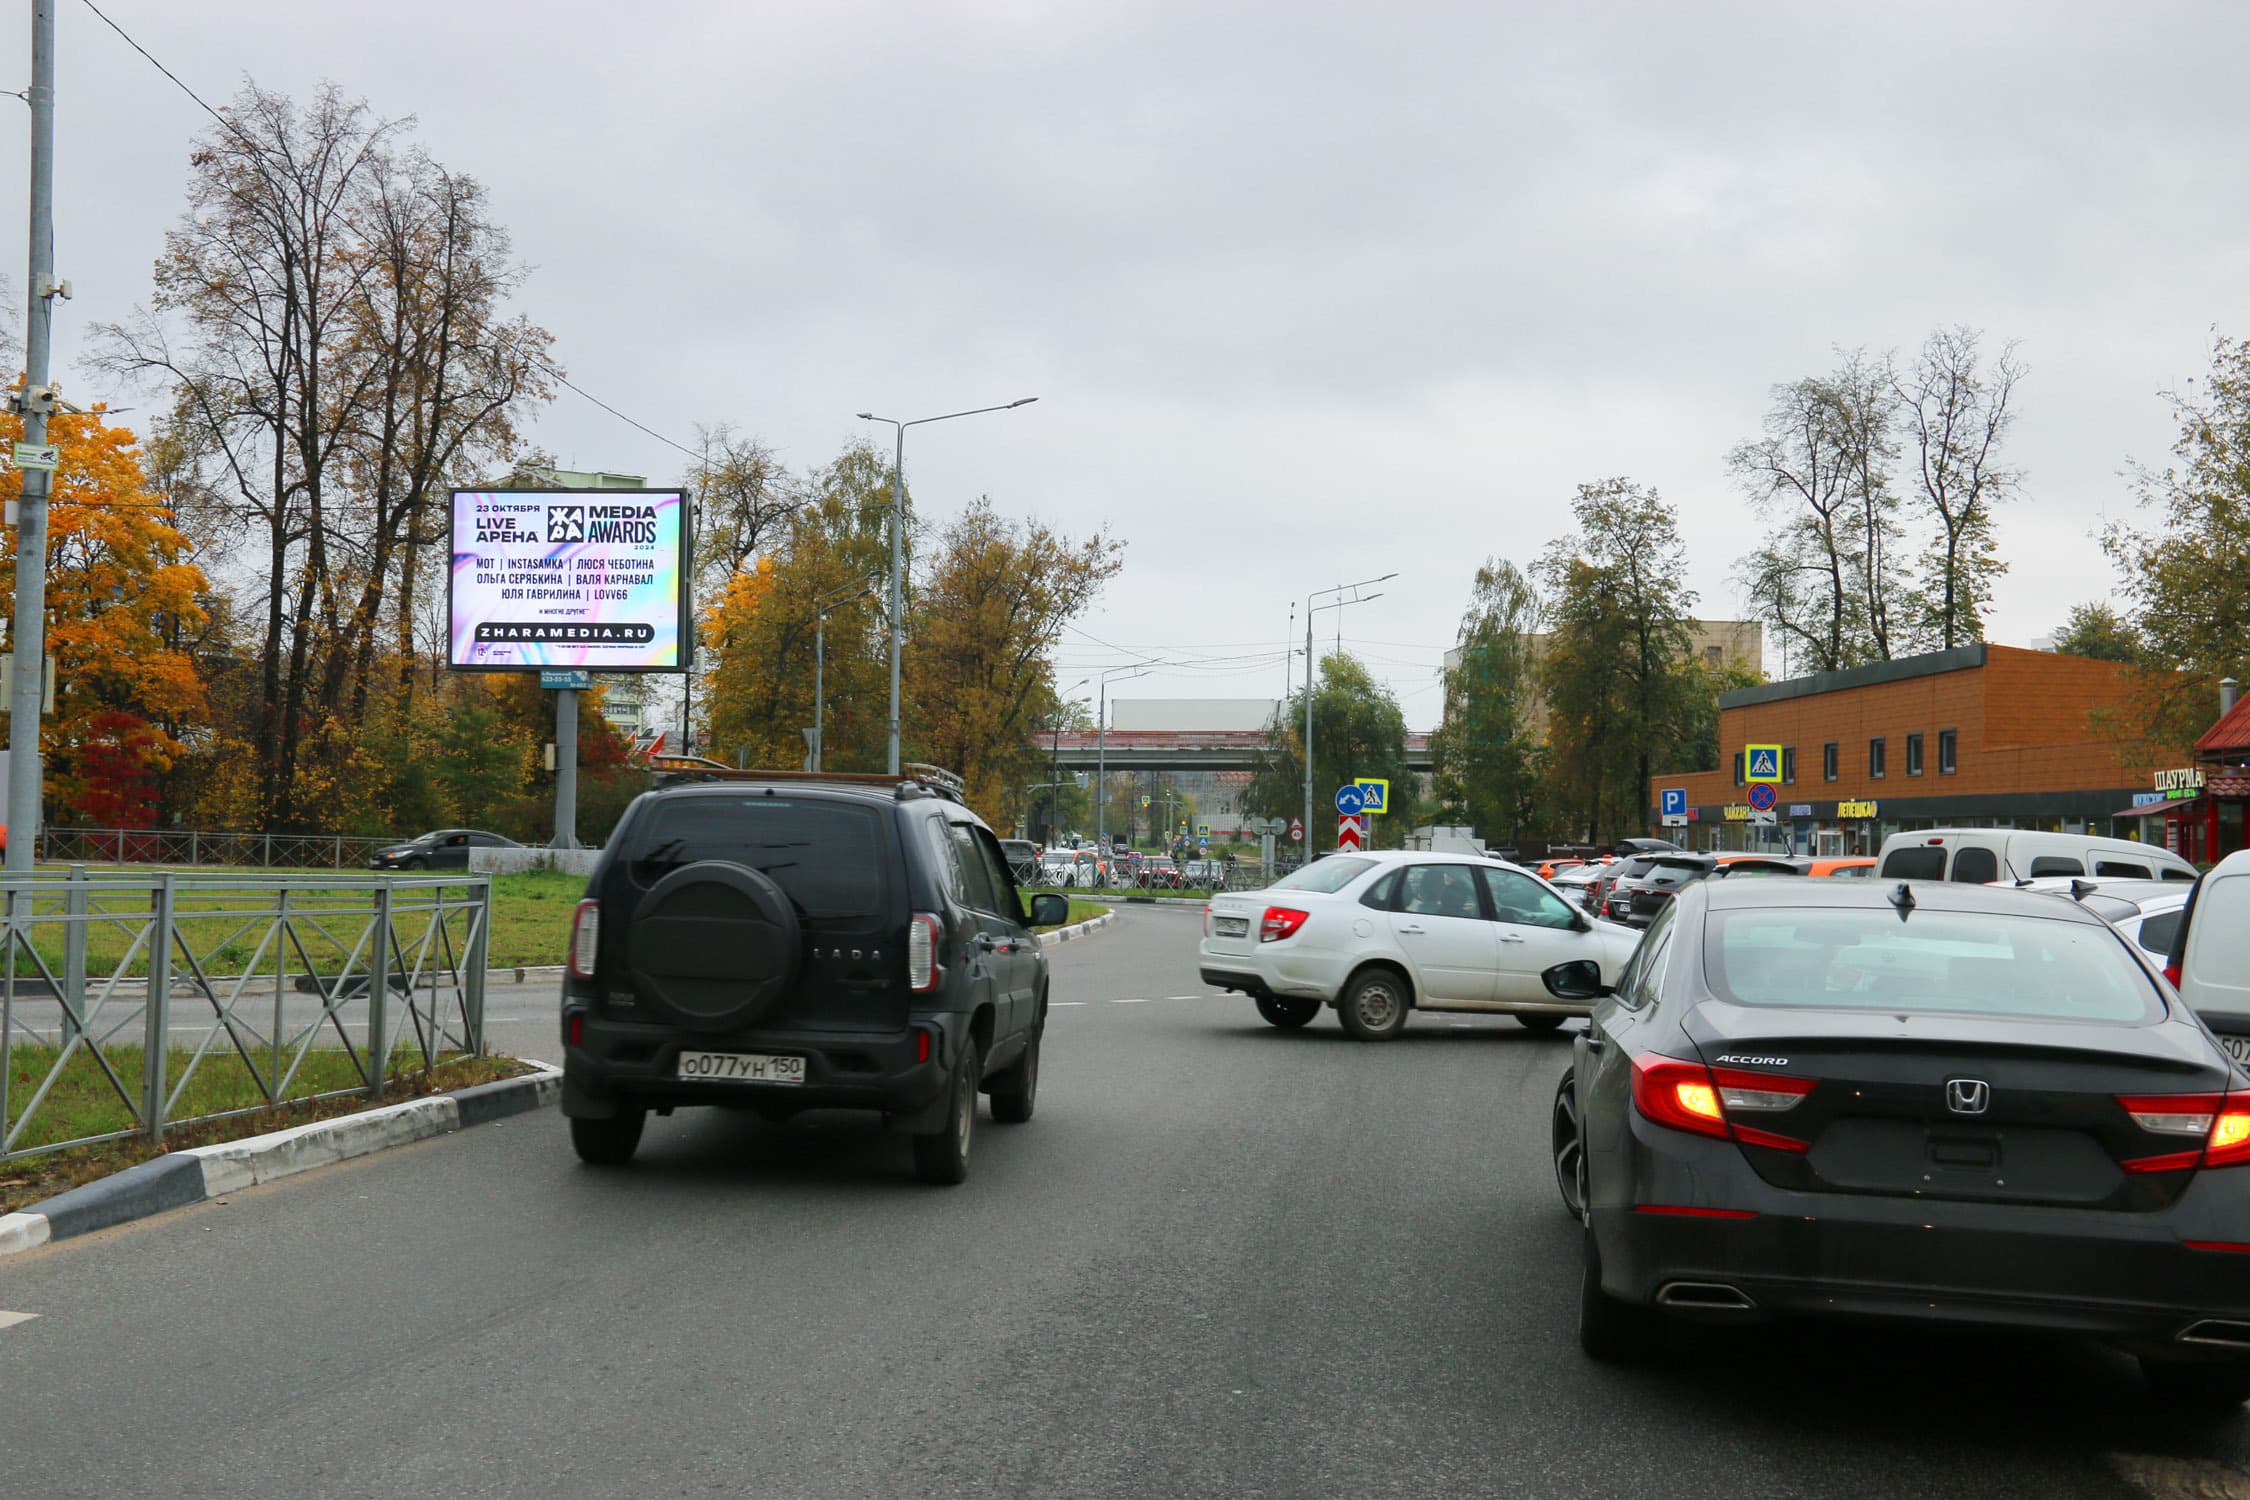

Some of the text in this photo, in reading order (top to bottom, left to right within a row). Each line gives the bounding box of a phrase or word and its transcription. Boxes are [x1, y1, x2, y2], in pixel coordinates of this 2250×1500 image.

[589, 506, 657, 519] MEDIA
[476, 518, 516, 529] LIVE
[476, 531, 539, 543] АРЕНА
[588, 521, 657, 543] AWARDS
[476, 559, 655, 569] МОТ INSTASAMKA ЛЮСЯ ЧЕБОТИНА
[476, 574, 653, 585] ОЛЬГА СЕРЯБКИНА ВАЛЯ КАРНАВАЛ
[501, 589, 628, 600] ЮЛЯ ГАВРИЛИНА LOVV66
[480, 628, 647, 638] ZHARAMEDIA.RU
[2154, 767, 2203, 791] ШАУРМА
[1837, 798, 1872, 818] ЛЕПЁШКА
[813, 948, 882, 960] LADA
[770, 1057, 800, 1073] 150
[1716, 1054, 1789, 1066] ACCORD
